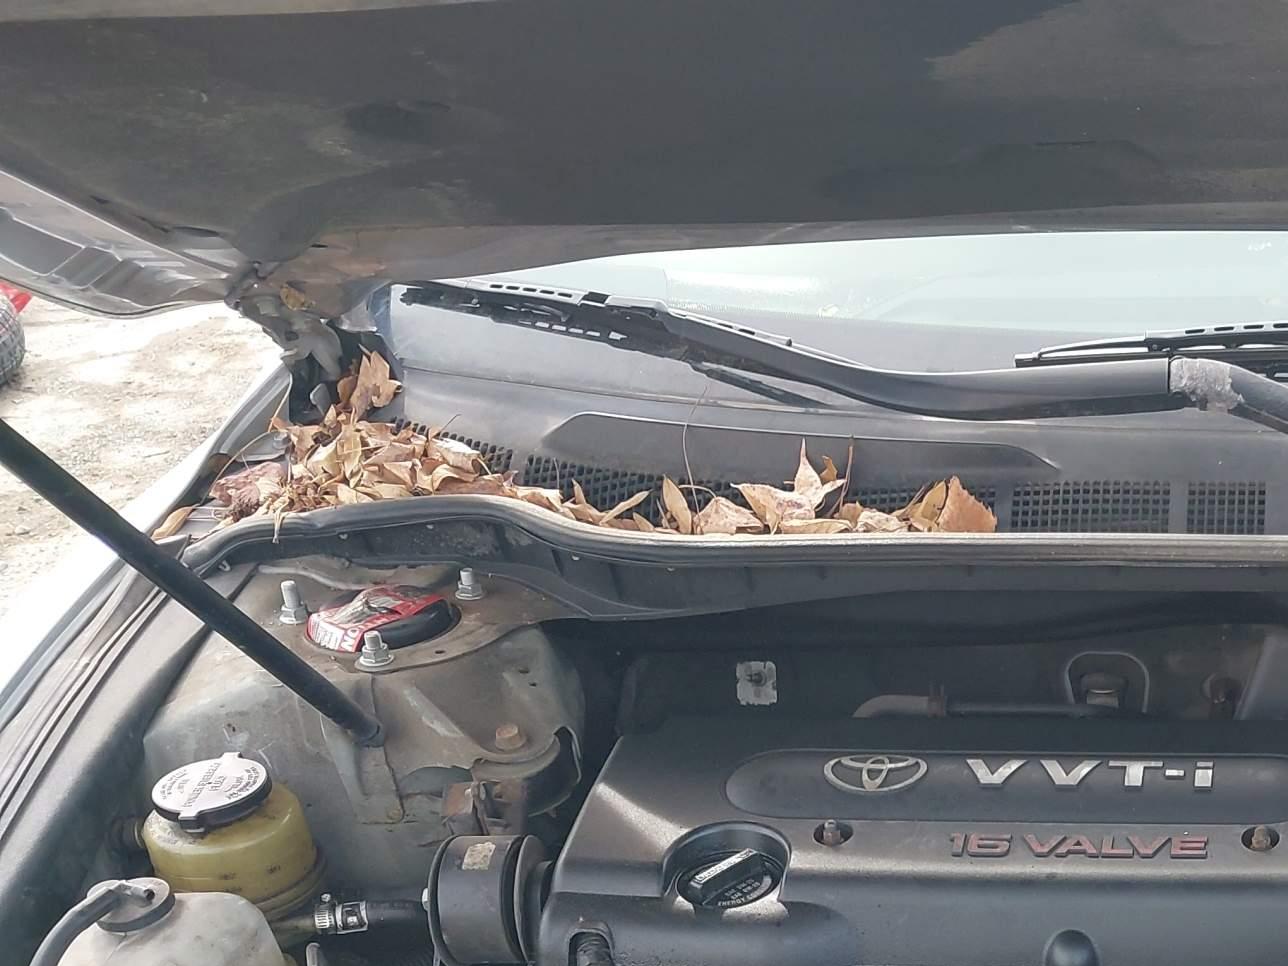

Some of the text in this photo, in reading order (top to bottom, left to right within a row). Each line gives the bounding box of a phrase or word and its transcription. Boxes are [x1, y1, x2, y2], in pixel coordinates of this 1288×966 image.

[964, 757, 1216, 788] VVT-i
[949, 833, 1209, 859] 16 VALVE
